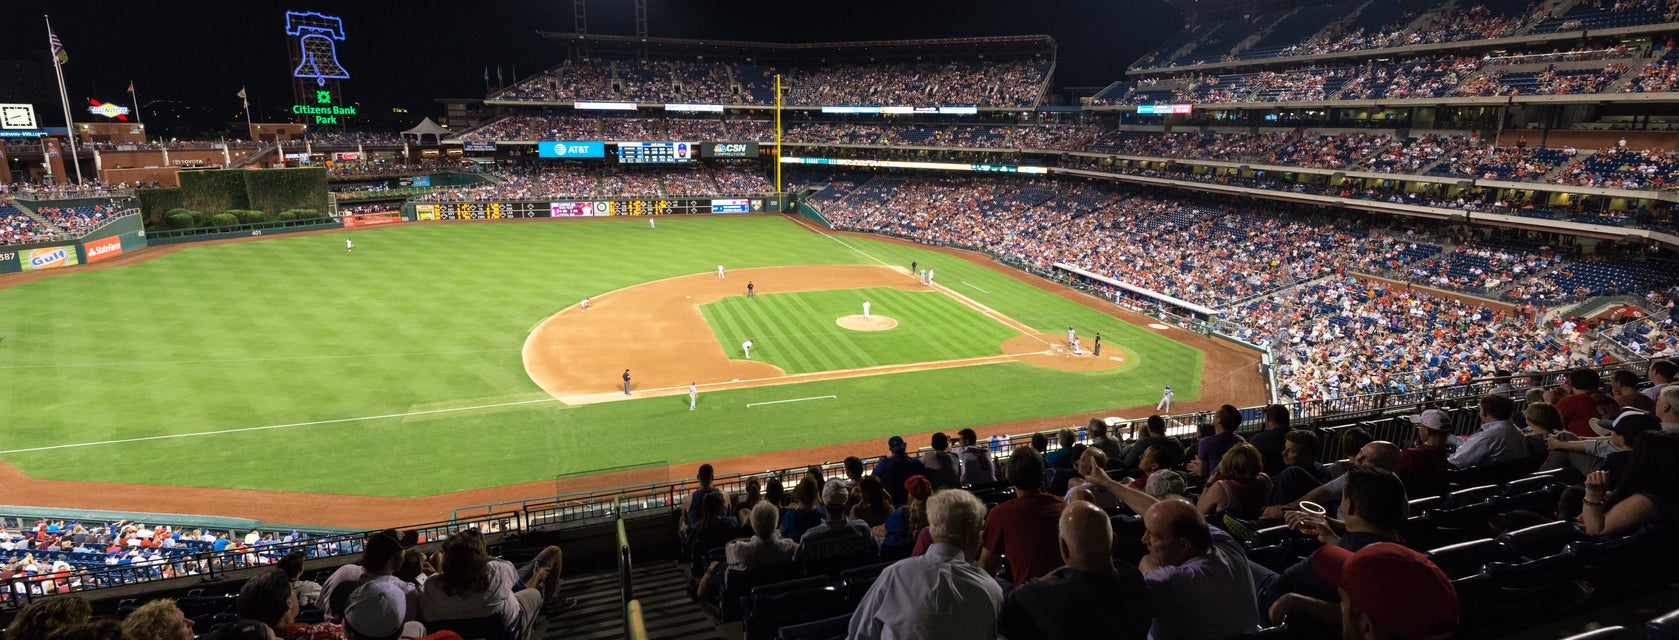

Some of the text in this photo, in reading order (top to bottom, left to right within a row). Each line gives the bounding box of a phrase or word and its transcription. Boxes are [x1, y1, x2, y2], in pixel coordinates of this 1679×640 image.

[293, 105, 356, 114] Citizens Bank
[316, 116, 336, 124] Park
[568, 146, 589, 154] AT&T
[726, 144, 746, 152] CSN
[32, 250, 66, 266] Gulf
